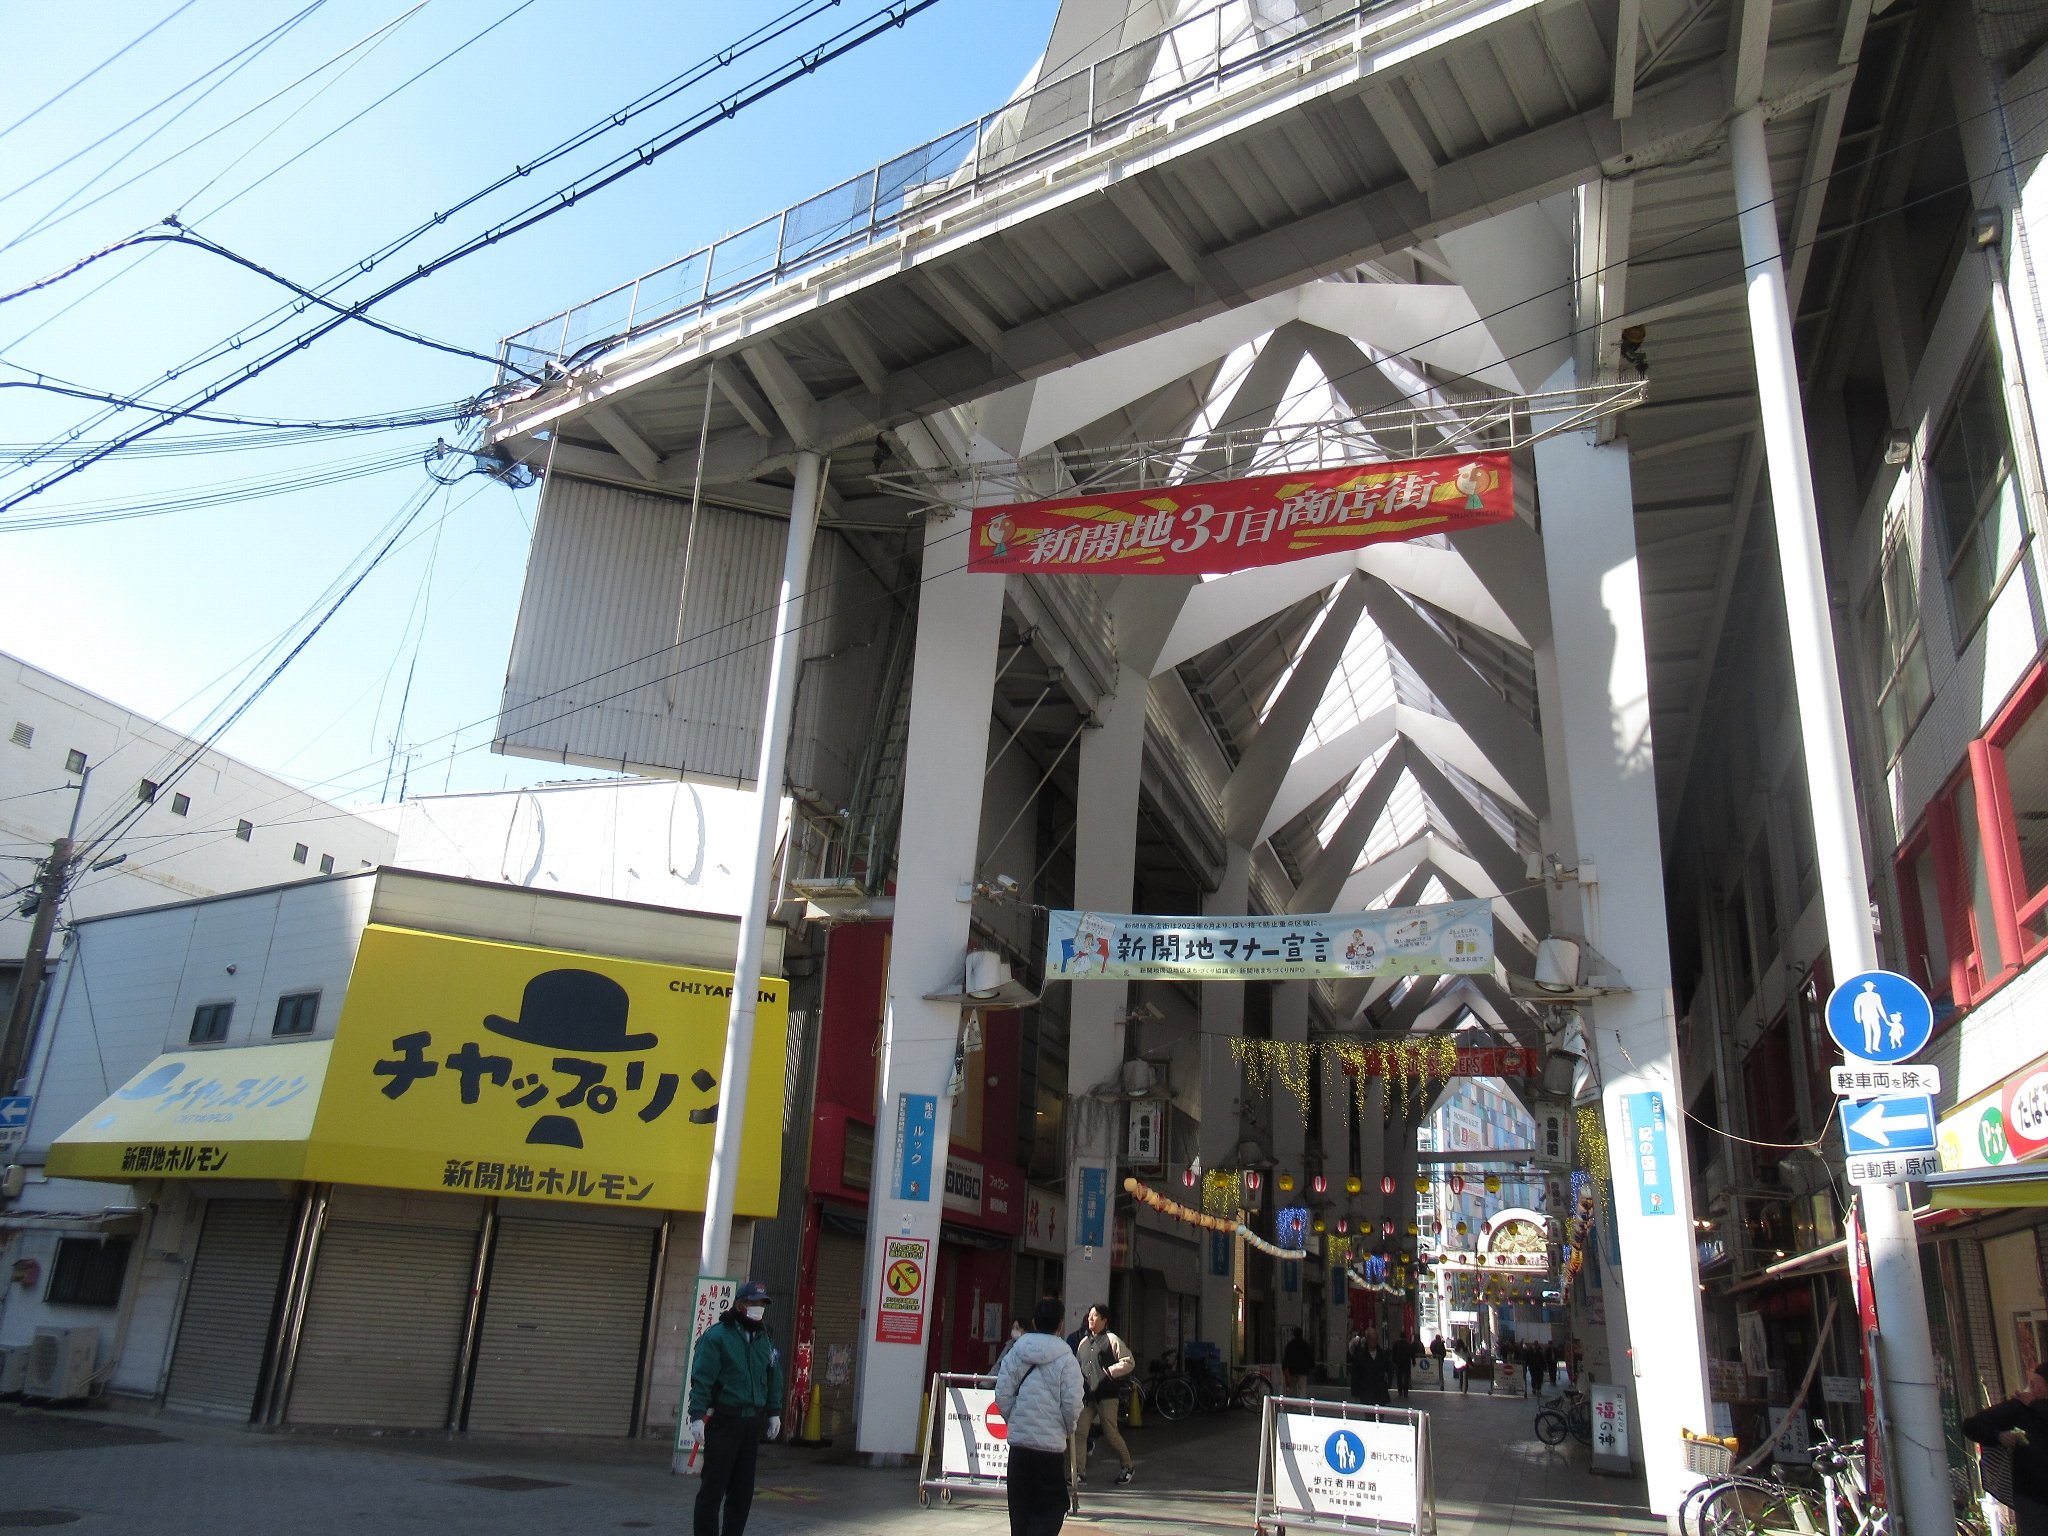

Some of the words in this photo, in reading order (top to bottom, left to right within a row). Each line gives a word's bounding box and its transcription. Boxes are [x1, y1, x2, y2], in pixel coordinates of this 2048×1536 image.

[1027, 471, 1437, 565] 新開地3丁目商店街
[1117, 932, 1330, 962] 新開地マナー宣言
[669, 980, 776, 1004] CHIYAPIN
[1837, 1072, 1932, 1090] 軽車両を除く
[911, 1125, 925, 1165] ルック
[1981, 1119, 2004, 1158] Pit
[121, 1146, 230, 1172] 新開地ホルモン
[442, 1158, 655, 1201] 新開地ホルモン
[720, 1285, 730, 1314] 鳩の
[695, 1293, 707, 1343] あたえ
[948, 1413, 981, 1422] 自転車は押して
[1596, 1402, 1616, 1447] 福の神
[1280, 1442, 1319, 1453] 自転車は押して
[1370, 1451, 1412, 1463] 通行して下さい
[1313, 1476, 1377, 1492] 歩行者用道路
